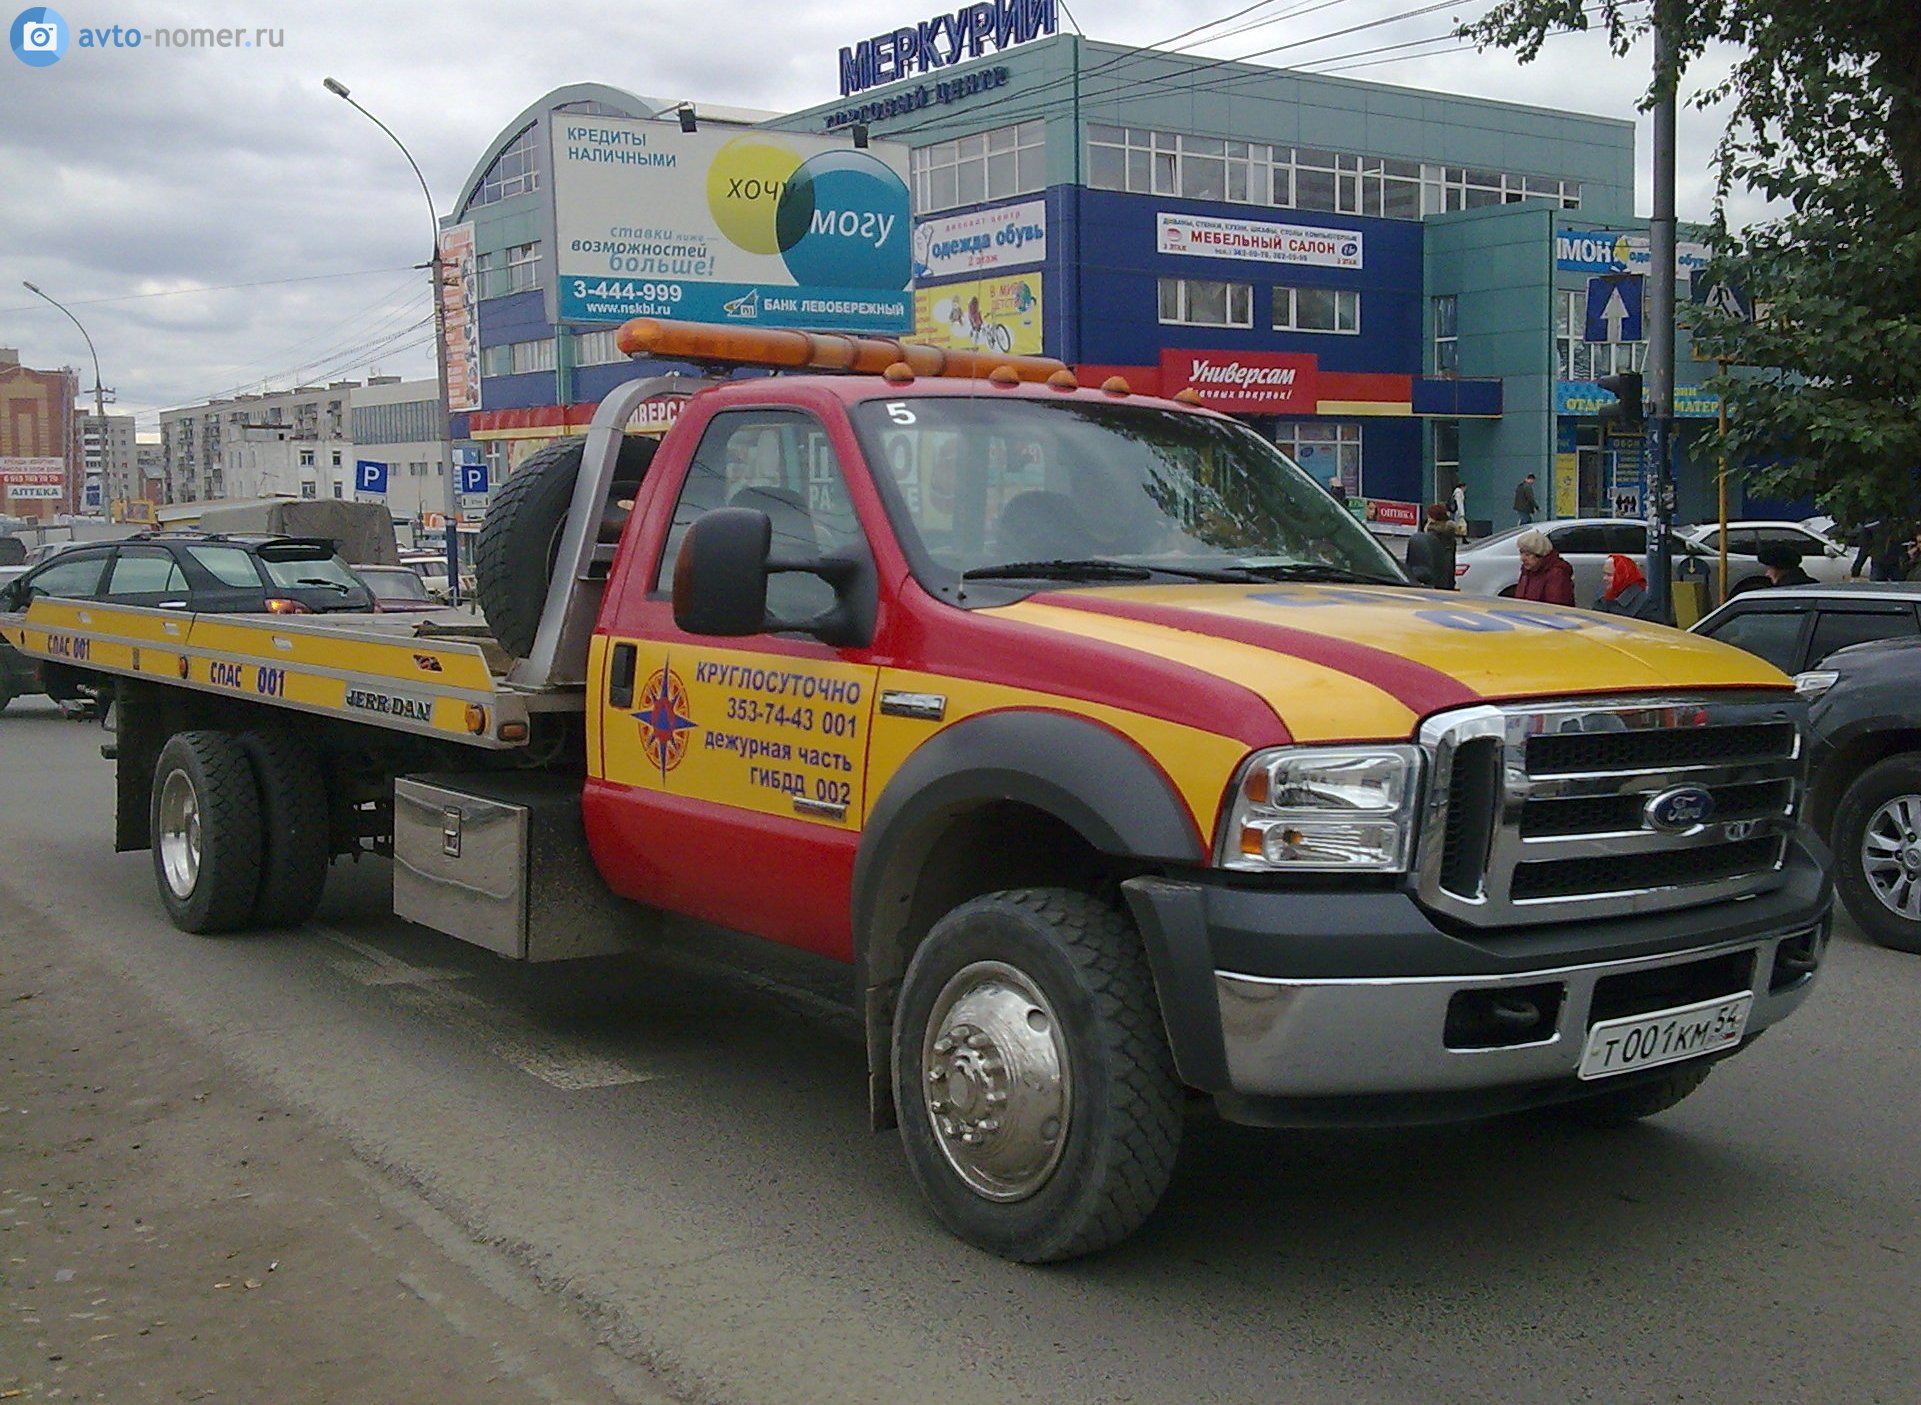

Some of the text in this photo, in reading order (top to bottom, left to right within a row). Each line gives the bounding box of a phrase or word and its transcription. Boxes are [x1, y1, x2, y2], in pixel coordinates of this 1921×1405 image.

[567, 127, 647, 147] КРЕДИТЫ
[567, 147, 678, 168] НАЛИЧНЫМИ
[996, 222, 1044, 248] обувь
[1190, 230, 1336, 254] МЕБЕЛЬНЫЙ САЛОН
[571, 238, 708, 260] возможностей
[572, 280, 683, 303] 3-444-999
[586, 301, 671, 316] www.nskbl.ru
[764, 299, 798, 312] БАНК
[801, 300, 905, 316] ЛЕВОБЕРЕЖНЫЙ
[1189, 359, 1296, 388] Универсам
[886, 402, 917, 425] 5
[363, 465, 380, 487] P
[467, 469, 482, 489] P
[11, 487, 59, 497] АПТЕКА
[47, 634, 90, 660] СПАС 001
[210, 661, 286, 697] СПАС 001
[696, 661, 861, 705] КРУГЛОСУТОЧНО
[727, 698, 857, 738] 353-74-43 001
[704, 730, 852, 772] дежурная часть
[750, 766, 851, 805] ГИБДД 002
